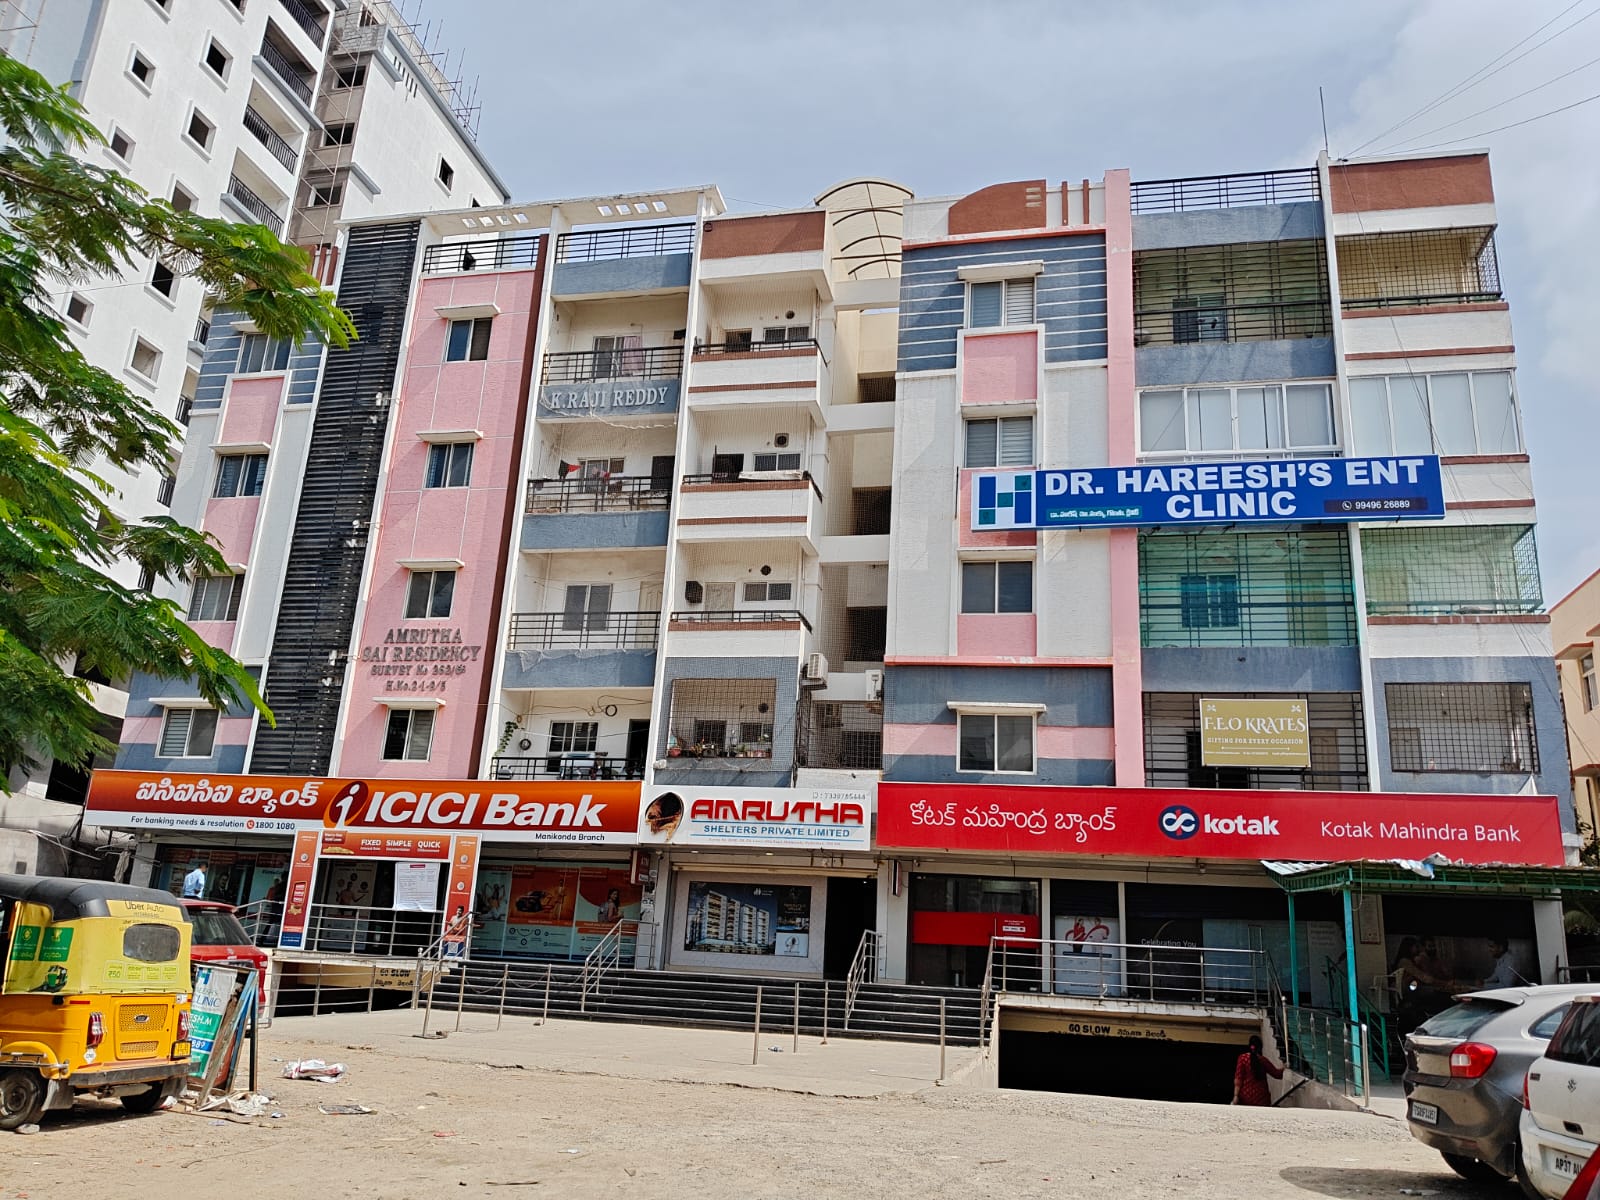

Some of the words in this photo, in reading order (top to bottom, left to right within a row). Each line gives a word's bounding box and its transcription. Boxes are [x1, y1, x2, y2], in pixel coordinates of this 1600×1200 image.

[551, 391, 607, 409] K.RAJI
[613, 387, 668, 406] REDDY
[1045, 472, 1104, 496] DR.
[1117, 463, 1333, 494] HAREESH'S
[1346, 459, 1425, 485] ENT
[1166, 491, 1297, 519] CLINIC
[1355, 501, 1382, 509] 99496
[1384, 500, 1410, 508] 26889
[384, 628, 463, 644] AMRUTHA
[361, 647, 389, 662] SAI
[392, 646, 481, 662] RESIDENCY
[371, 665, 413, 676] SURVEY
[1245, 716, 1306, 734] KRATES
[364, 791, 480, 824] ICICI
[481, 794, 608, 827] Bank
[690, 799, 863, 825] AMRUTHA
[130, 815, 142, 823] For
[144, 816, 174, 827] banking
[200, 819, 206, 827] &
[207, 820, 245, 829] resolution
[255, 821, 274, 829] 1800
[276, 822, 296, 831] 1080
[910, 800, 957, 826] కోటక్
[1054, 806, 1117, 843] బ్యాంక్
[1204, 813, 1279, 836] kotak
[535, 832, 577, 842] Manikonda
[579, 833, 605, 842] Branch
[704, 824, 757, 834] SHELTERS
[761, 827, 804, 836] PRIVATE
[808, 828, 849, 837] LIMITED
[1321, 821, 1374, 838] Kotak
[1379, 822, 1468, 841] Mahindra
[1475, 824, 1521, 842] Bank
[417, 841, 440, 849] QUICK
[125, 899, 145, 910] Uber
[147, 904, 164, 912] Auto
[1141, 939, 1181, 948] Celebrating
[1069, 1023, 1080, 1033] GO
[1083, 1024, 1110, 1034] SLOW
